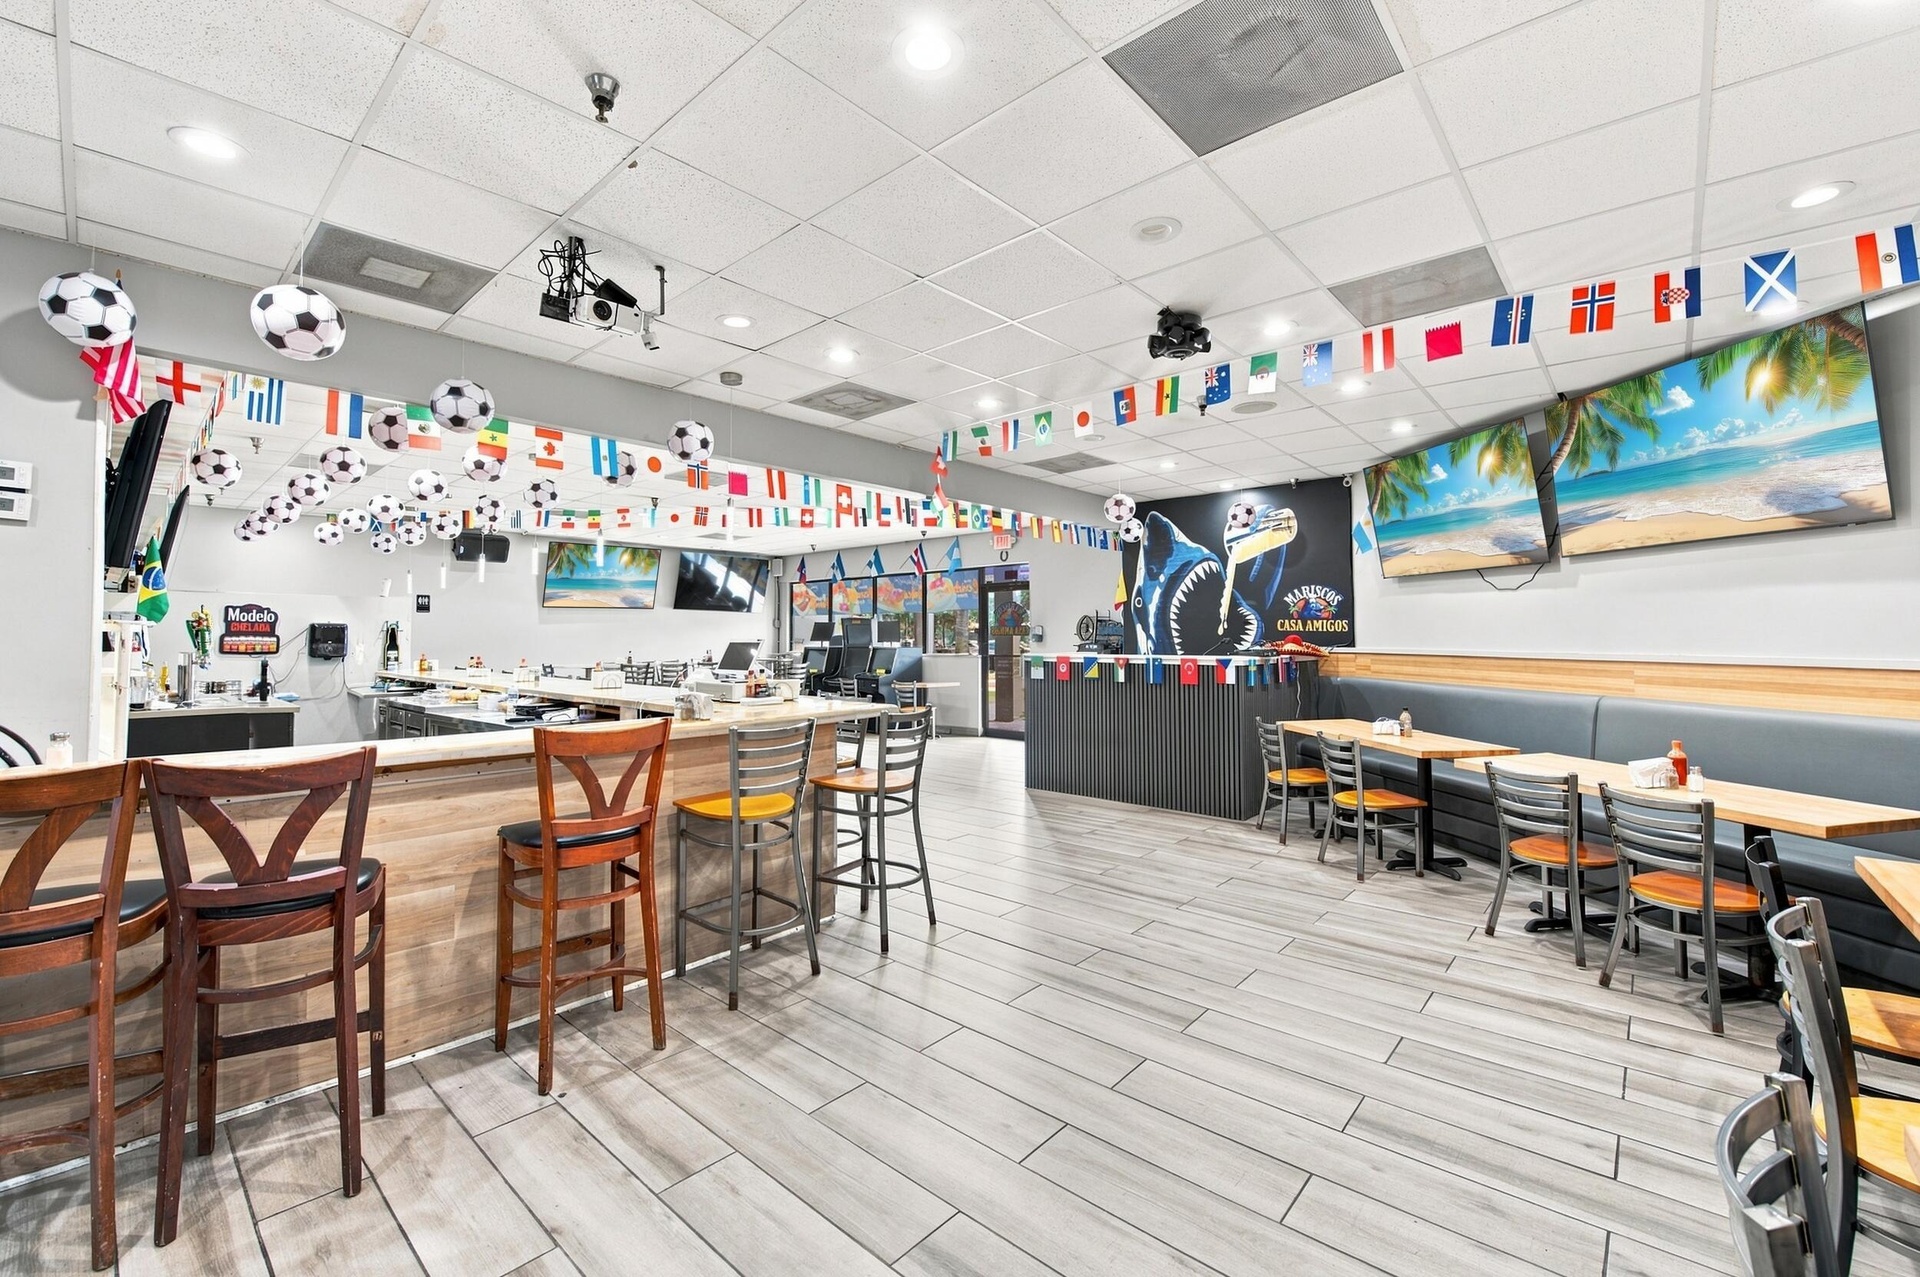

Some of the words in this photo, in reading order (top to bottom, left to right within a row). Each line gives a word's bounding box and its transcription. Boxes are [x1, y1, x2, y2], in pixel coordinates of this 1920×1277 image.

[1283, 585, 1342, 606] MARISCOS
[228, 607, 275, 622] Modelo
[231, 622, 270, 632] CHELADA
[1277, 619, 1303, 632] CASA
[1305, 619, 1349, 632] AMIGOS
